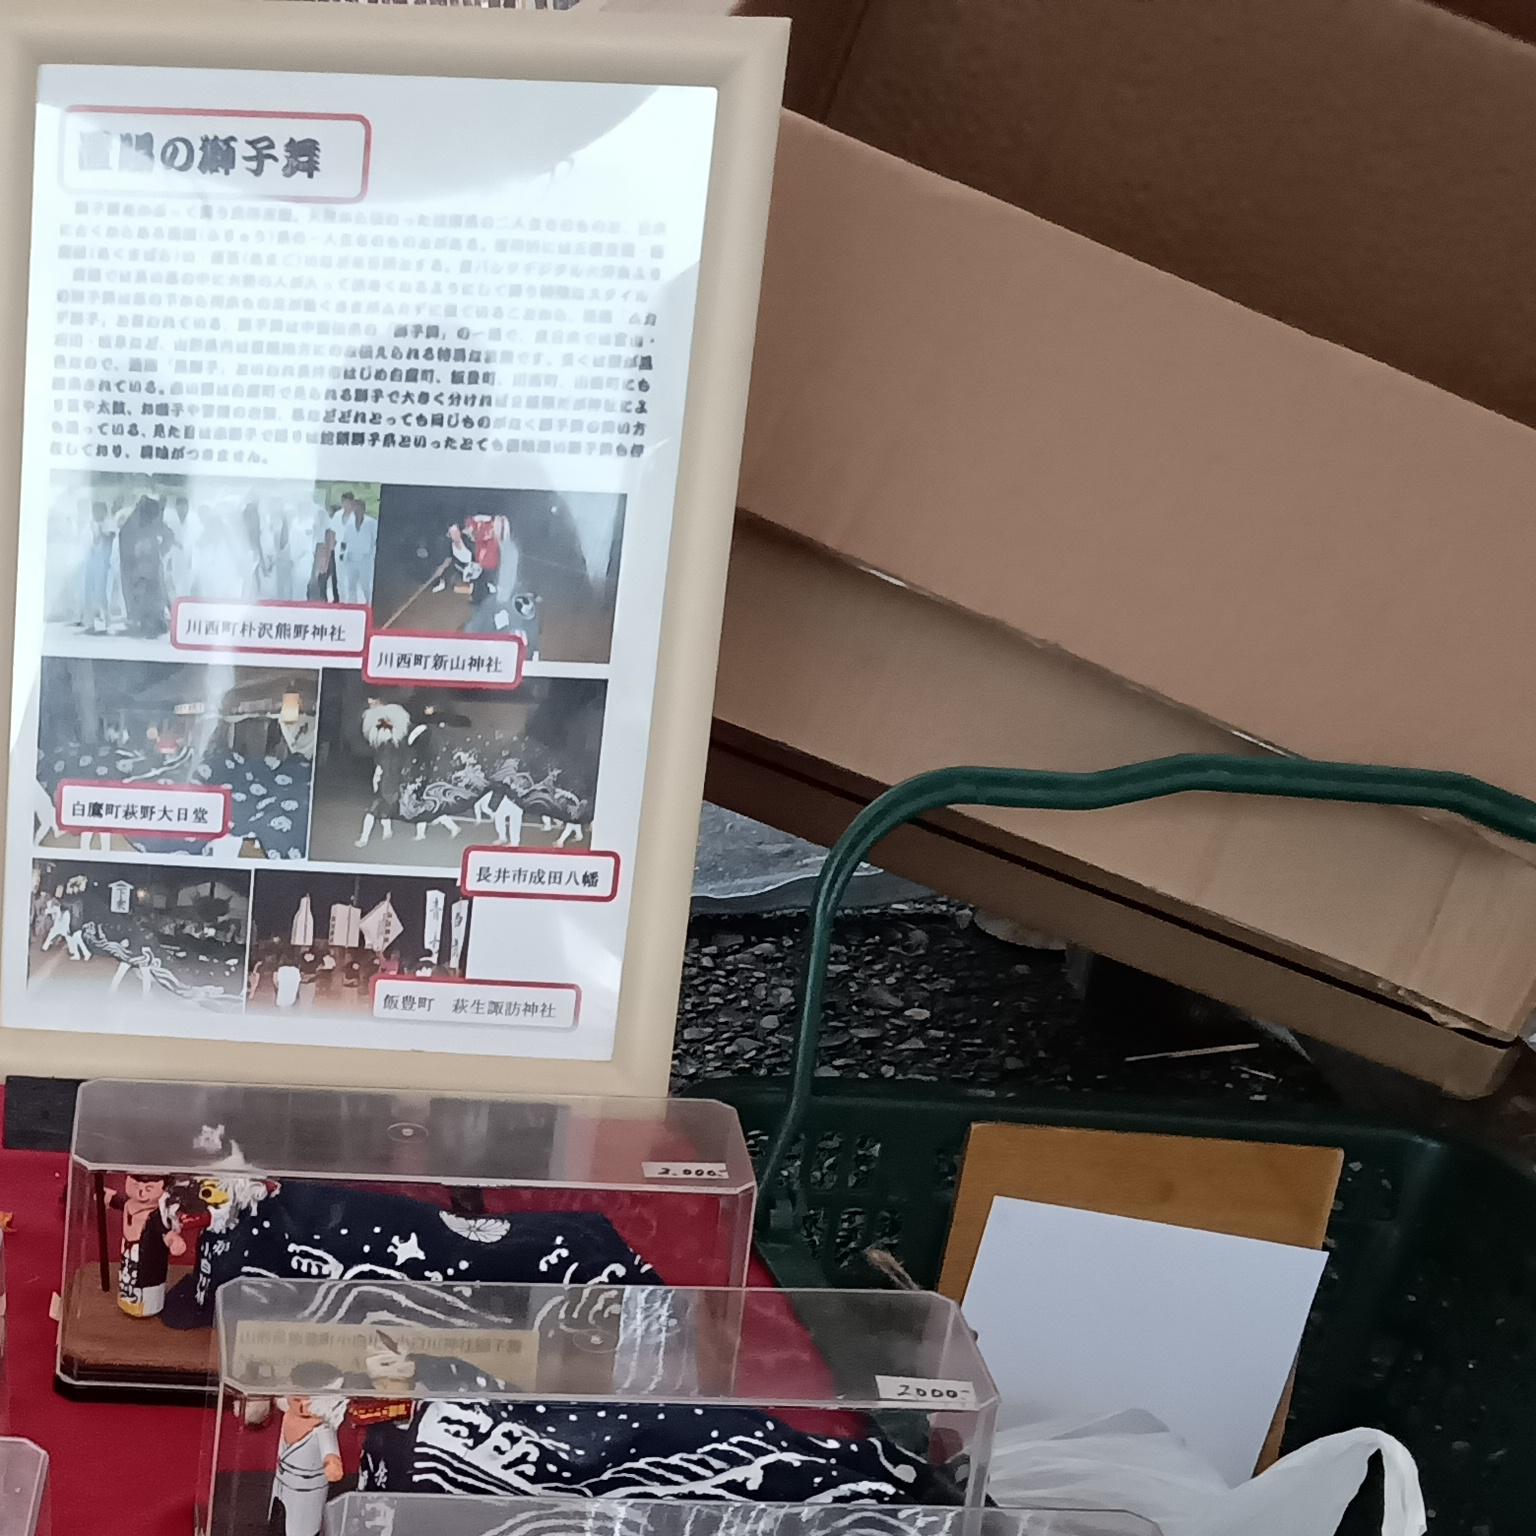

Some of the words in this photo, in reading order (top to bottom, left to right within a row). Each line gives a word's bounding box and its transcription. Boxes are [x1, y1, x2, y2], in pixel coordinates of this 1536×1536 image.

[376, 651, 503, 674] 川西町新山神社
[71, 800, 209, 825] 白鷹町萩野大日堂
[475, 865, 600, 889] 長井市成田八幡
